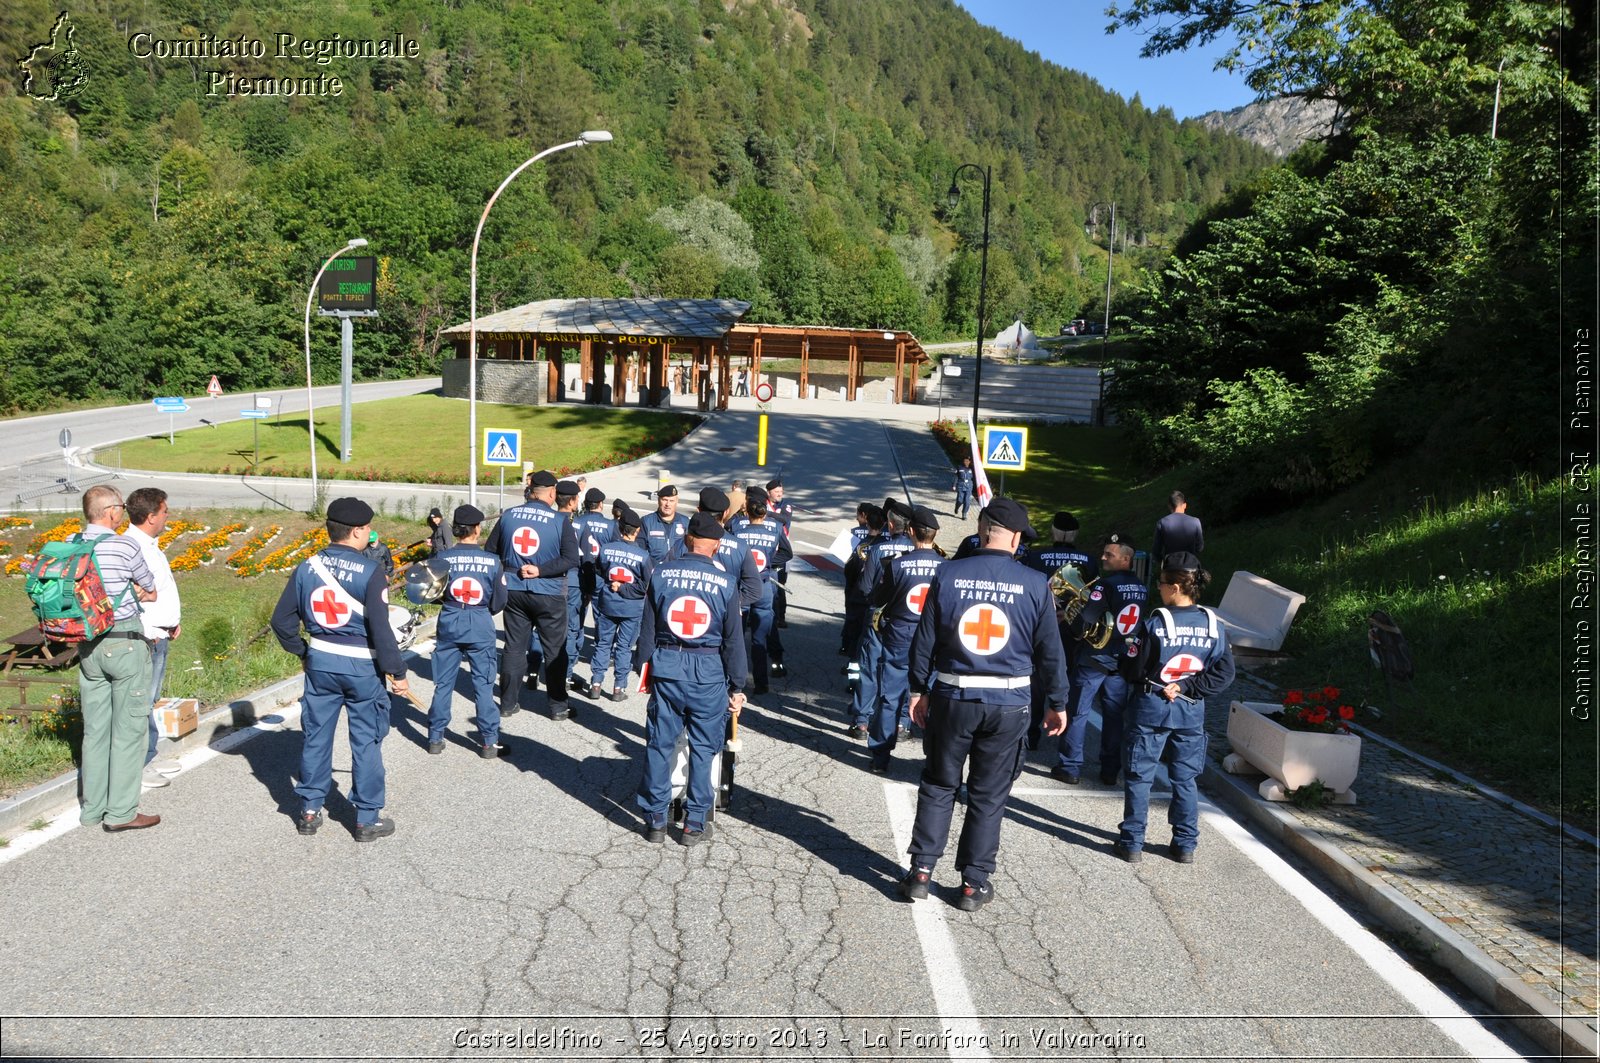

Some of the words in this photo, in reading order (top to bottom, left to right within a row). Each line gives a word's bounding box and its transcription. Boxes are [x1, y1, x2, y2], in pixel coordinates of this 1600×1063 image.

[489, 333, 514, 341] PLEIN
[517, 333, 532, 341] AIR
[584, 334, 607, 343] DEL
[512, 512, 548, 524] FANFARA
[606, 555, 637, 567] FANFARA
[916, 559, 933, 568] ROSSA
[1055, 552, 1070, 560] ROSSA
[1069, 553, 1089, 563] ITALIANA
[337, 559, 365, 574] ITALIANA
[905, 567, 936, 577] FANFA
[661, 569, 681, 578] CROCE
[680, 569, 701, 580] ROSSA
[701, 571, 728, 589] ITALIANA
[666, 578, 719, 595] FANFARA
[954, 579, 975, 589] CROCE
[975, 579, 996, 591] ROSSA
[996, 581, 1024, 595] ITALIANA
[960, 589, 1015, 605] FANFARA
[1163, 636, 1212, 649] FANFARA
